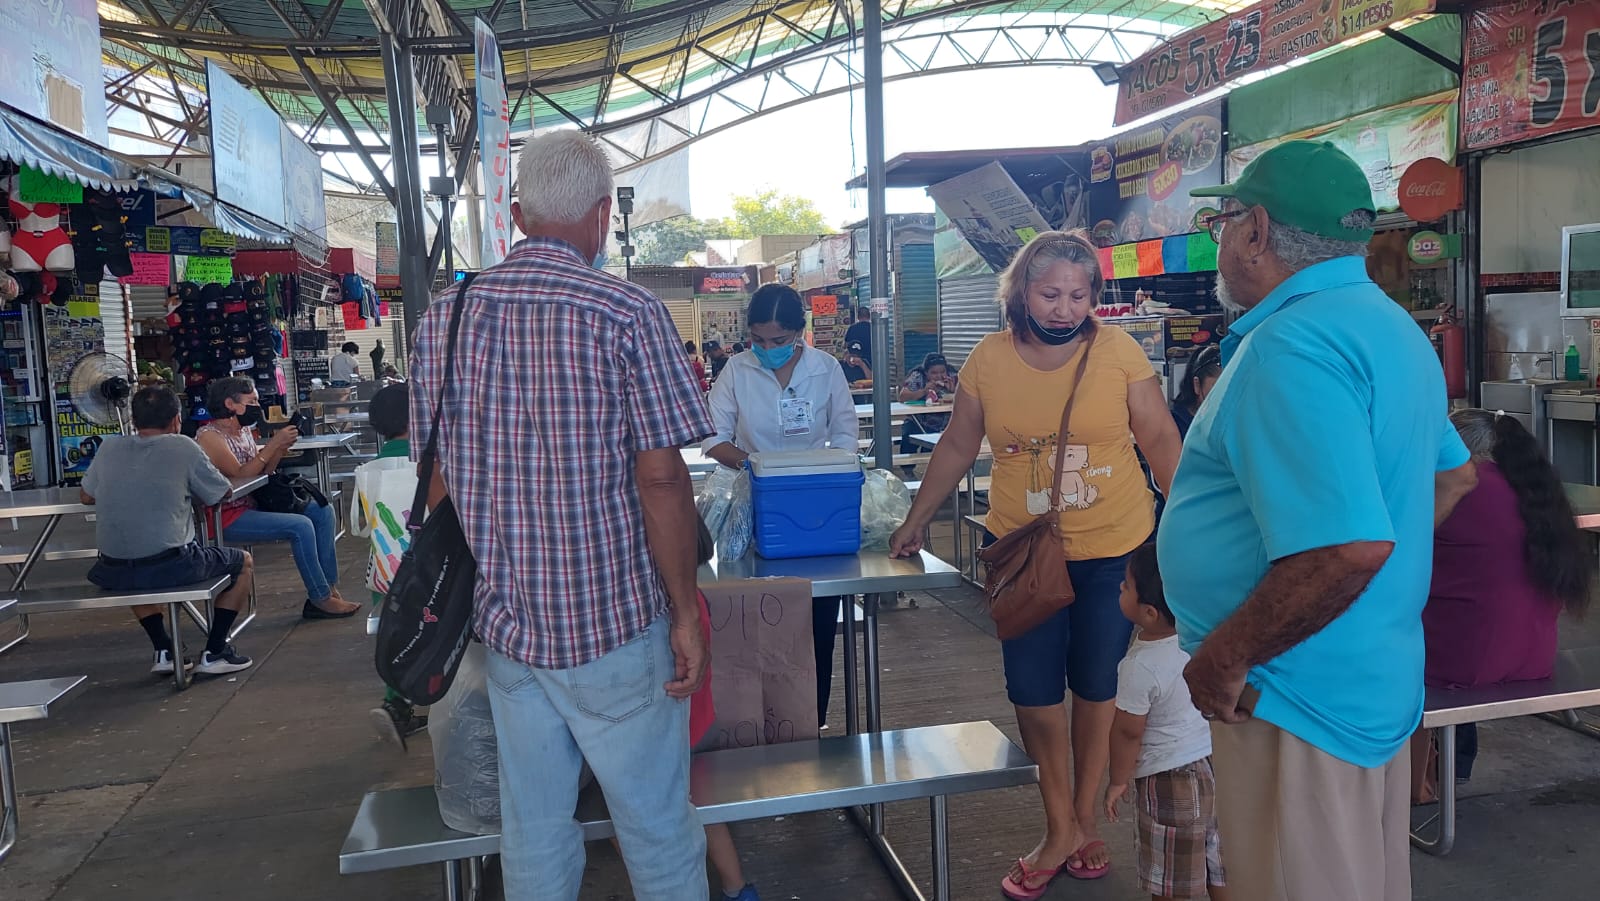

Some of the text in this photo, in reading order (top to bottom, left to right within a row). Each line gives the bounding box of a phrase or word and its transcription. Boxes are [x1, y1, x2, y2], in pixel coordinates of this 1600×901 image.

[1363, 1, 1394, 27] PESOS
[1281, 29, 1320, 57] PASTOR
[1467, 62, 1490, 80] AGUA
[1412, 239, 1441, 251] baz
[59, 423, 122, 437] ELULARES
[1085, 465, 1113, 478] strong
